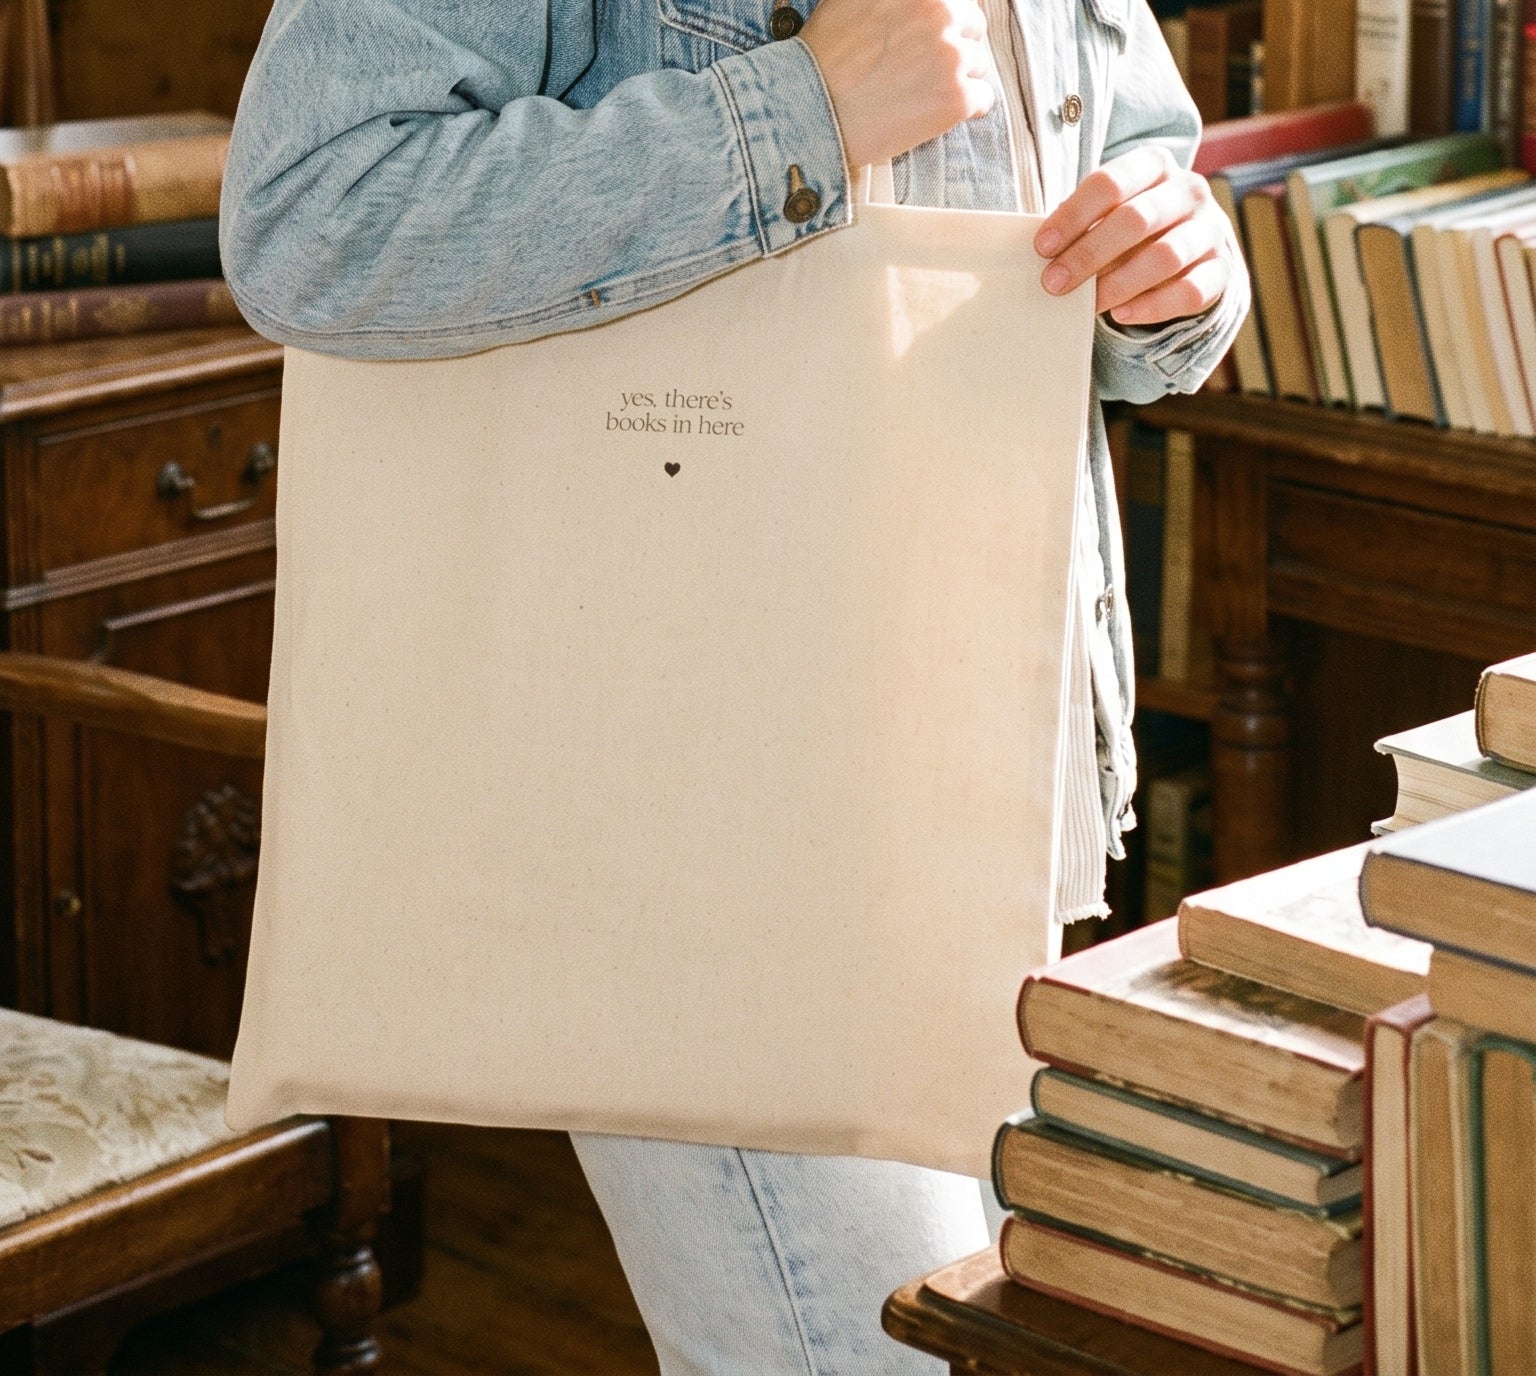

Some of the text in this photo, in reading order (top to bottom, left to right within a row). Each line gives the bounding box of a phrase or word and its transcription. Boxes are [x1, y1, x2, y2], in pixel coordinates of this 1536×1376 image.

[665, 388, 733, 410] there's
[605, 411, 745, 436] books in here
